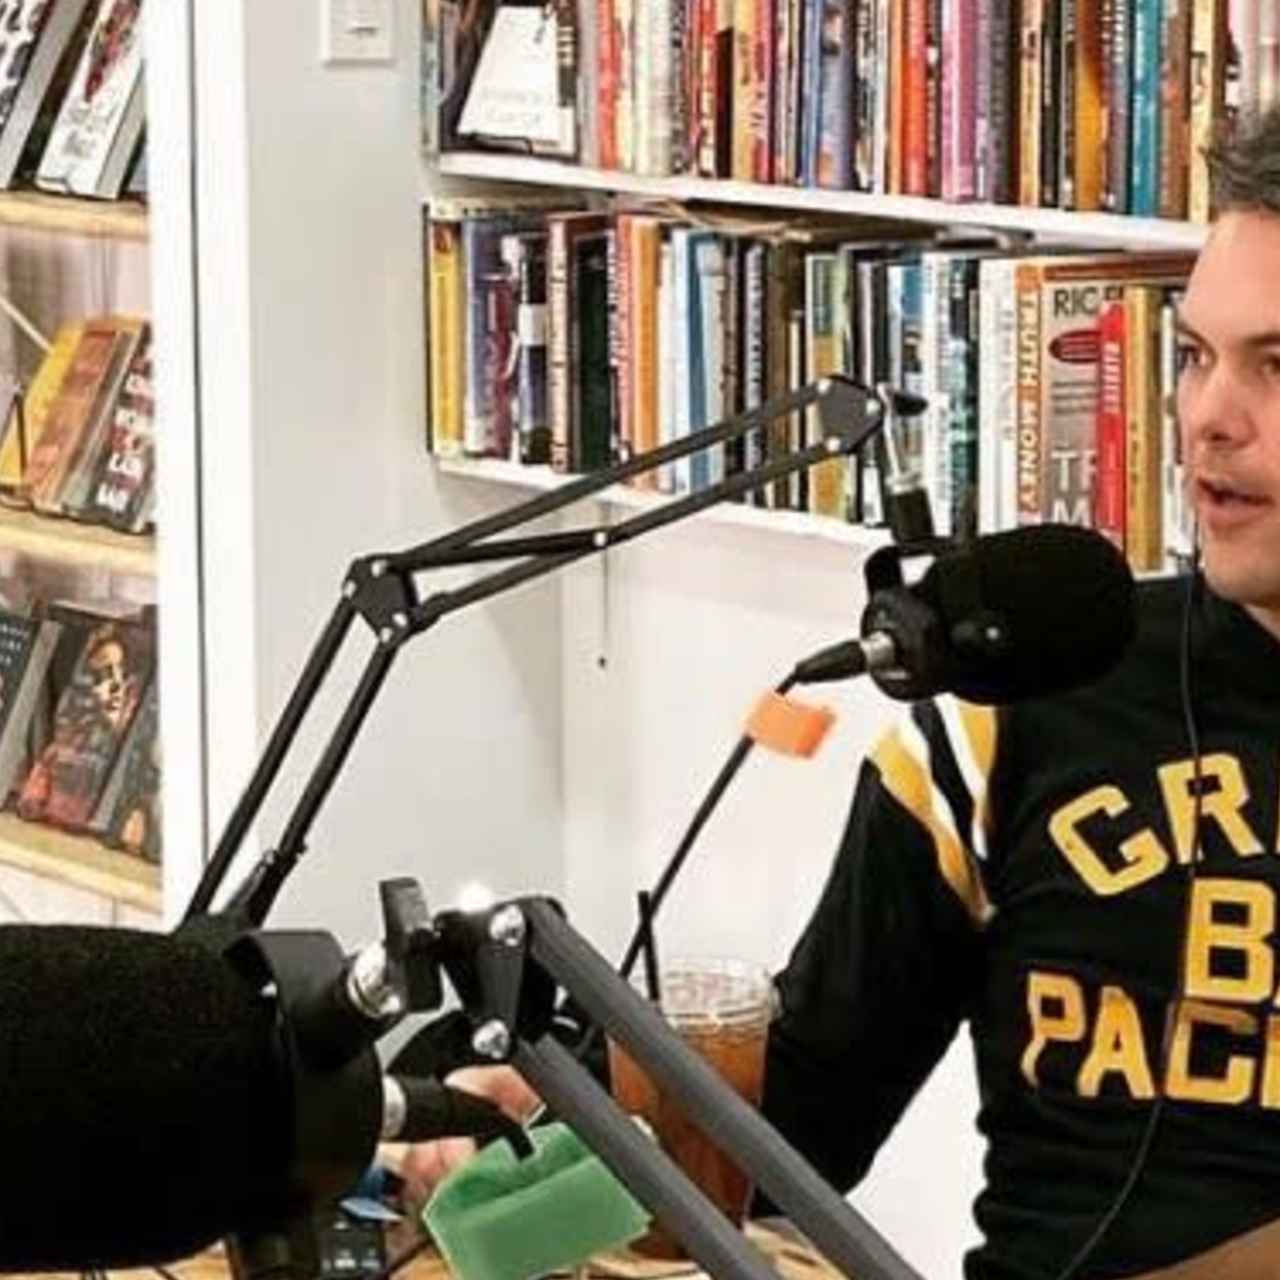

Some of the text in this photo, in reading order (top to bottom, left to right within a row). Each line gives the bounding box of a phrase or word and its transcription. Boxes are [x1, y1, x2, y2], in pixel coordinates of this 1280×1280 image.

[1053, 286, 1099, 318] RIC
[1018, 289, 1040, 509] TRUTH MONEY
